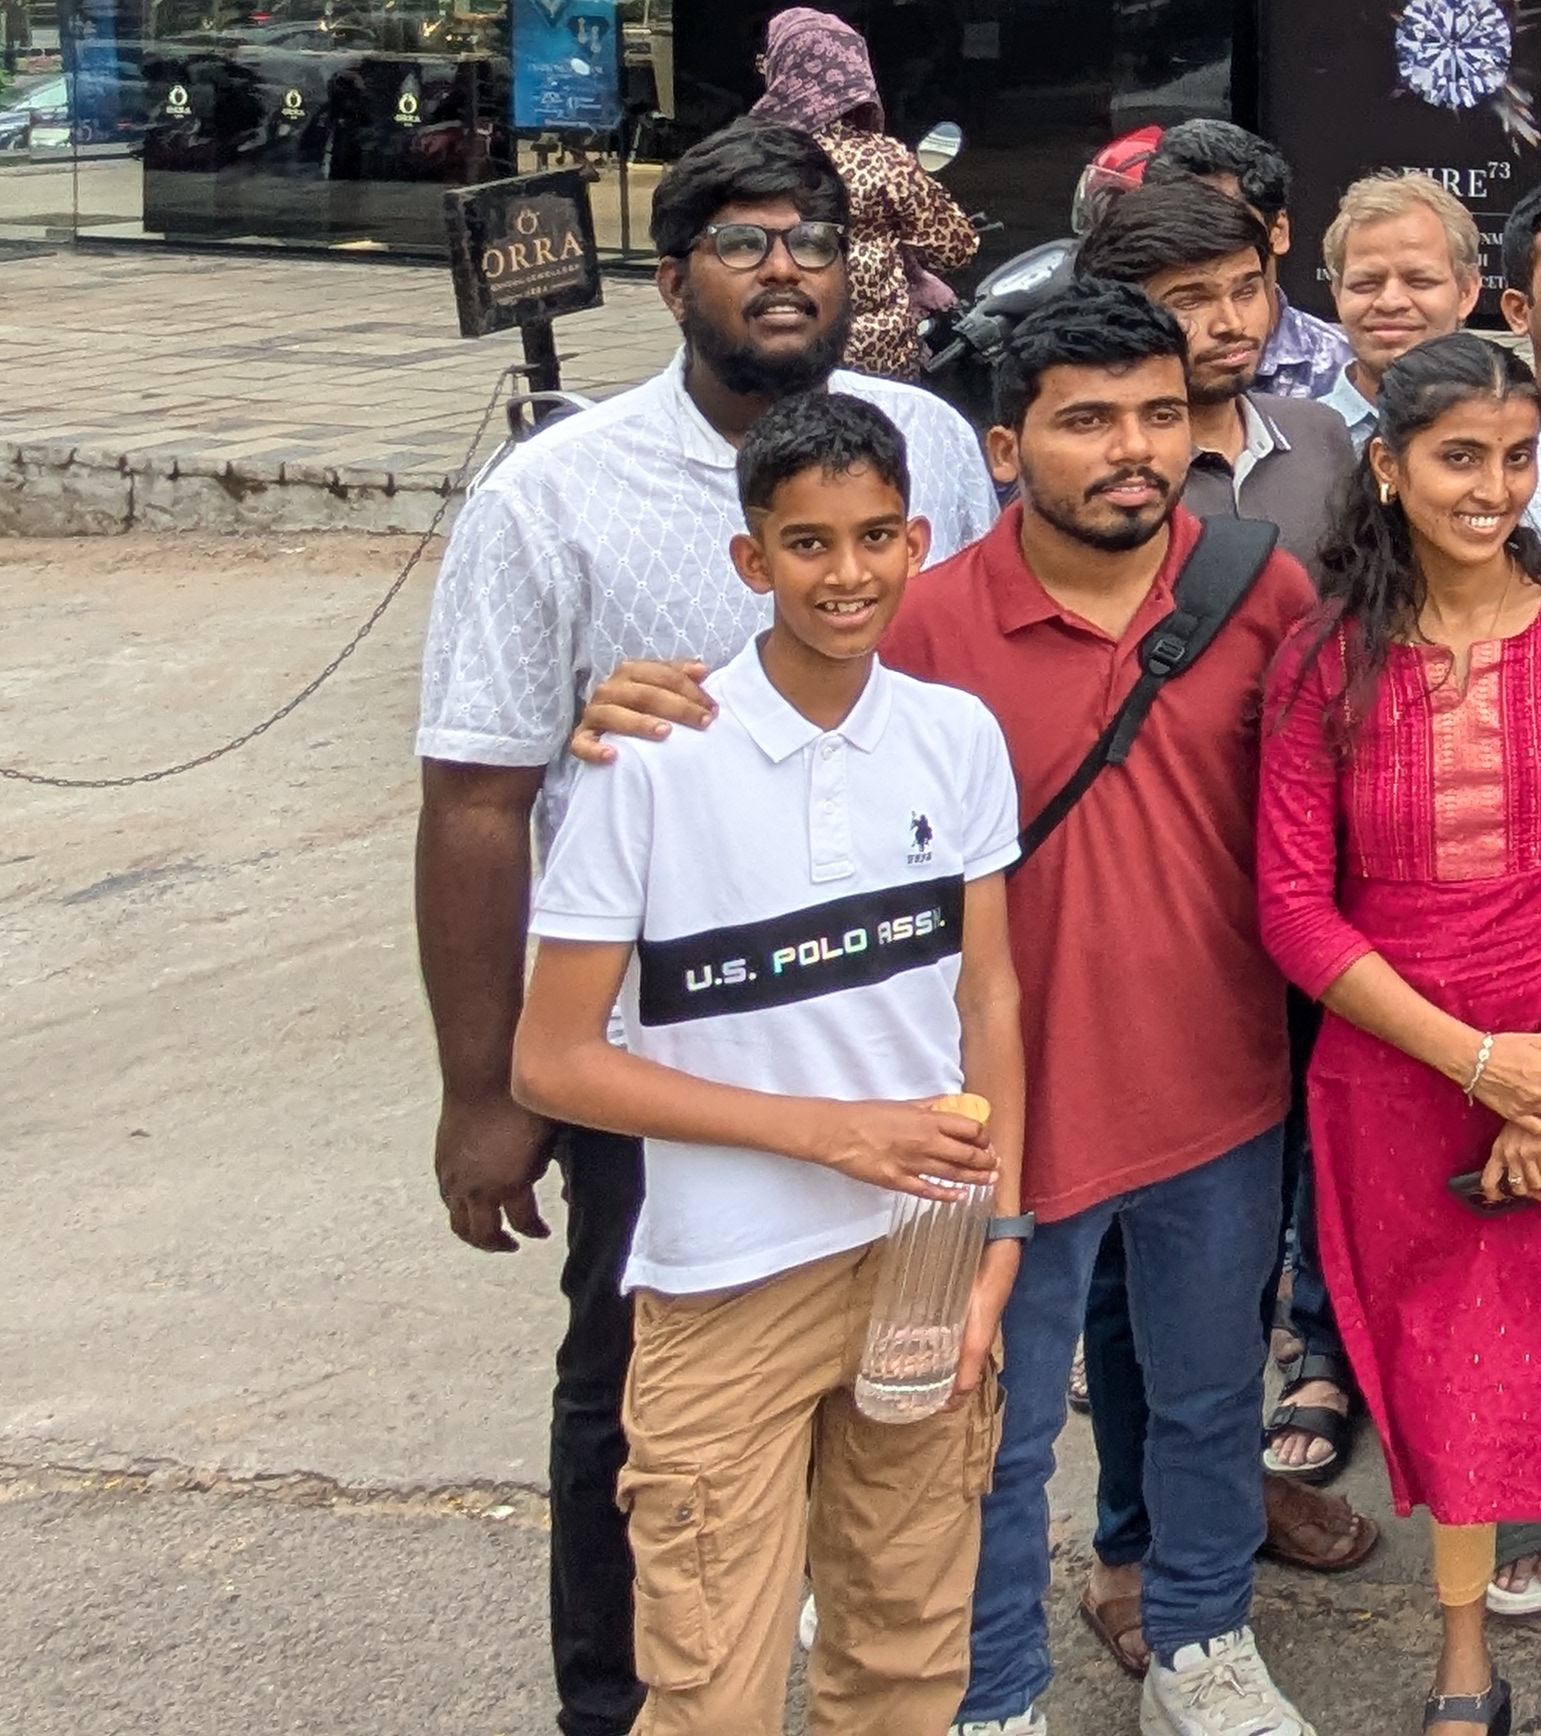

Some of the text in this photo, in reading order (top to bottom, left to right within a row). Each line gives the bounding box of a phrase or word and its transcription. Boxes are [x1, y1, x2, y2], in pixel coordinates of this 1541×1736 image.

[482, 230, 584, 279] ORRA
[686, 958, 757, 993] U.S.
[772, 928, 868, 975] POLO
